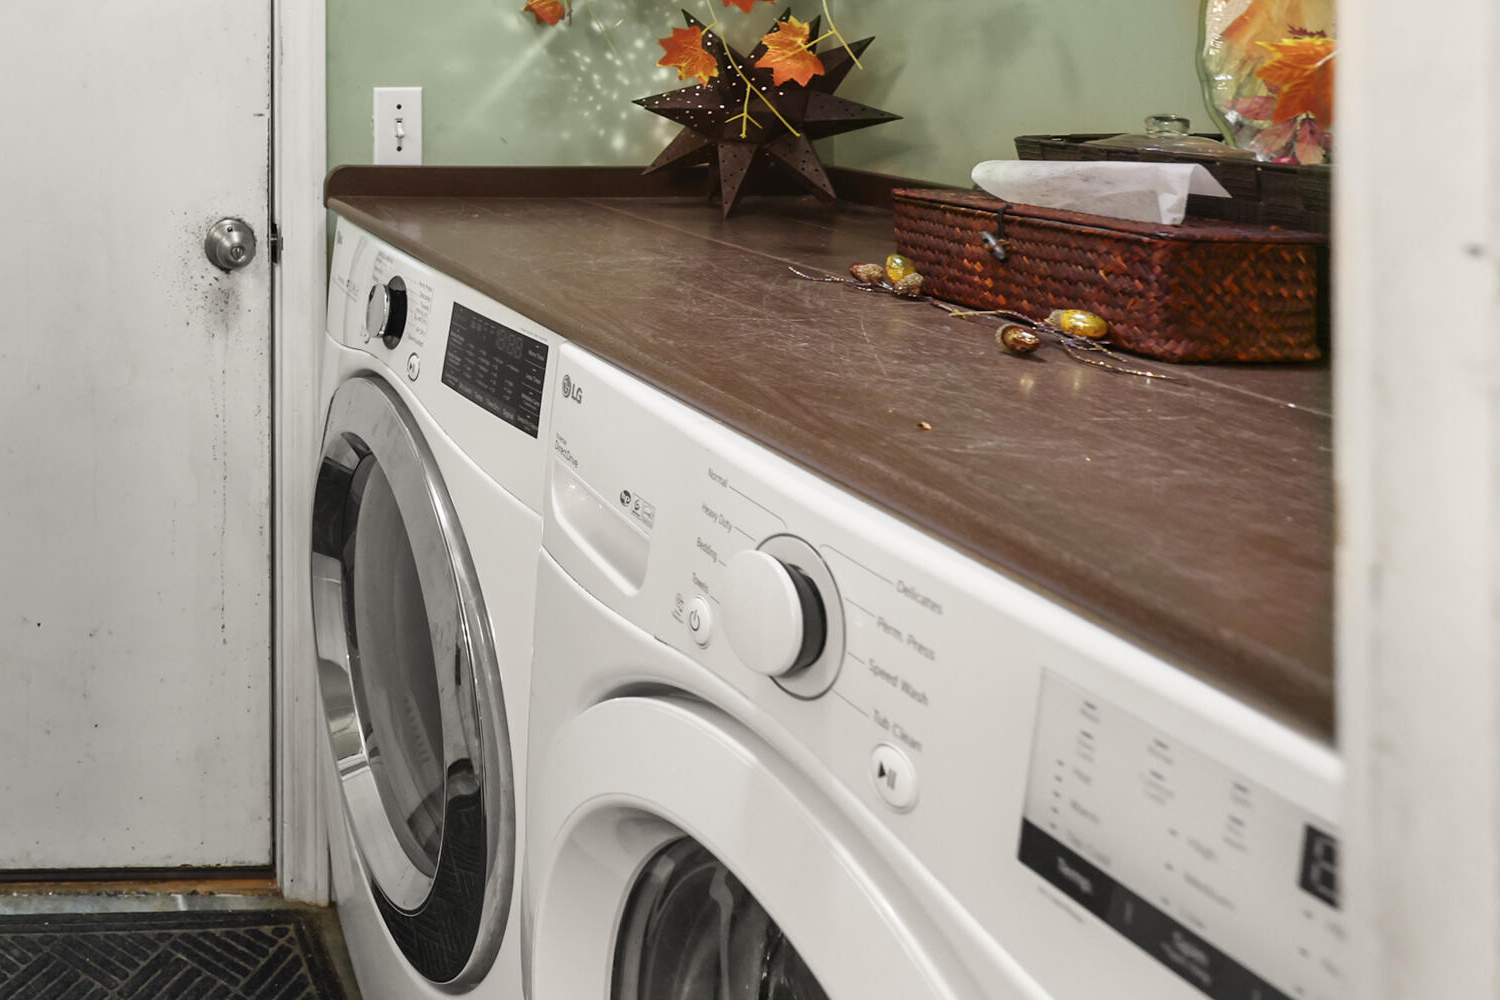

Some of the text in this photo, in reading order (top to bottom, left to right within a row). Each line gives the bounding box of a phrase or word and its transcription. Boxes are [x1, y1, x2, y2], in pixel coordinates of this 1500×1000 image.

[718, 513, 733, 533] Duty
[896, 579, 943, 616] Delicates
[906, 634, 936, 661] Press
[868, 657, 929, 706] Speed Wash
[873, 708, 923, 752] Tub Clean
